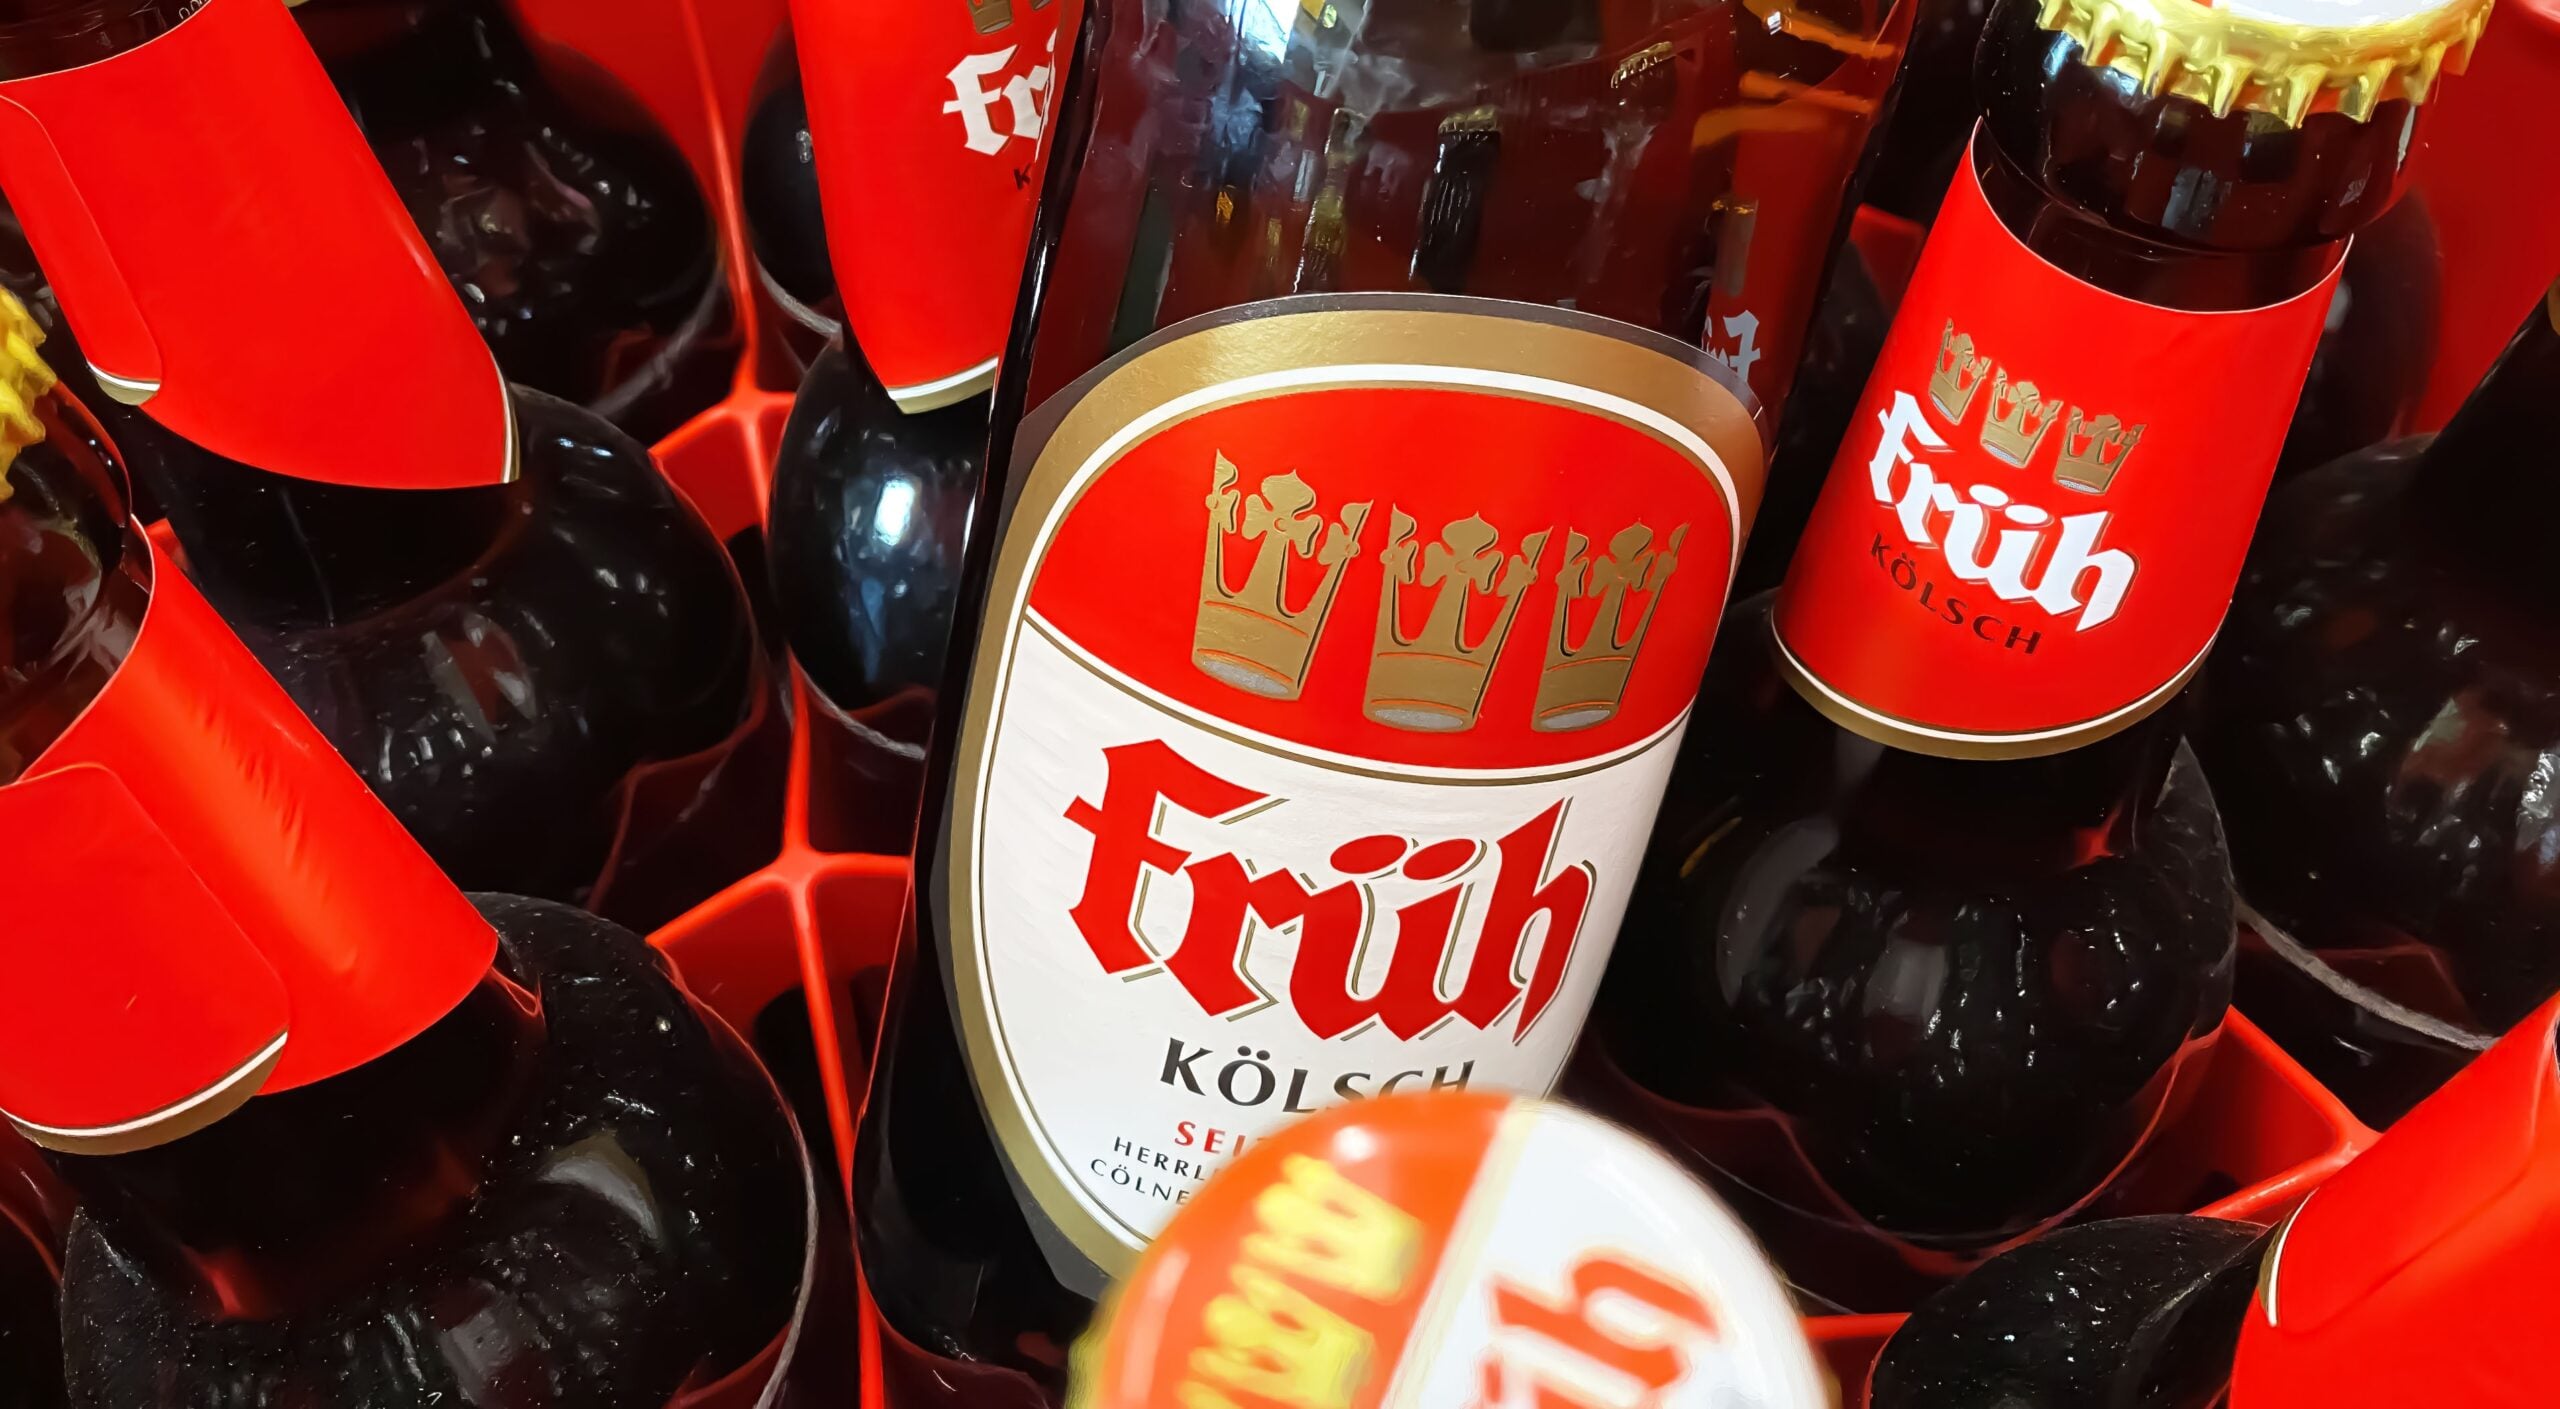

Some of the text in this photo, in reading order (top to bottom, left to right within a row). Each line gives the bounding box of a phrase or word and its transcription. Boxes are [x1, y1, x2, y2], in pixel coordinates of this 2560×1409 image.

[1869, 390, 2139, 632] Früh
[1870, 532, 2042, 654] KÖLSCH
[1063, 739, 1597, 1045] Früh
